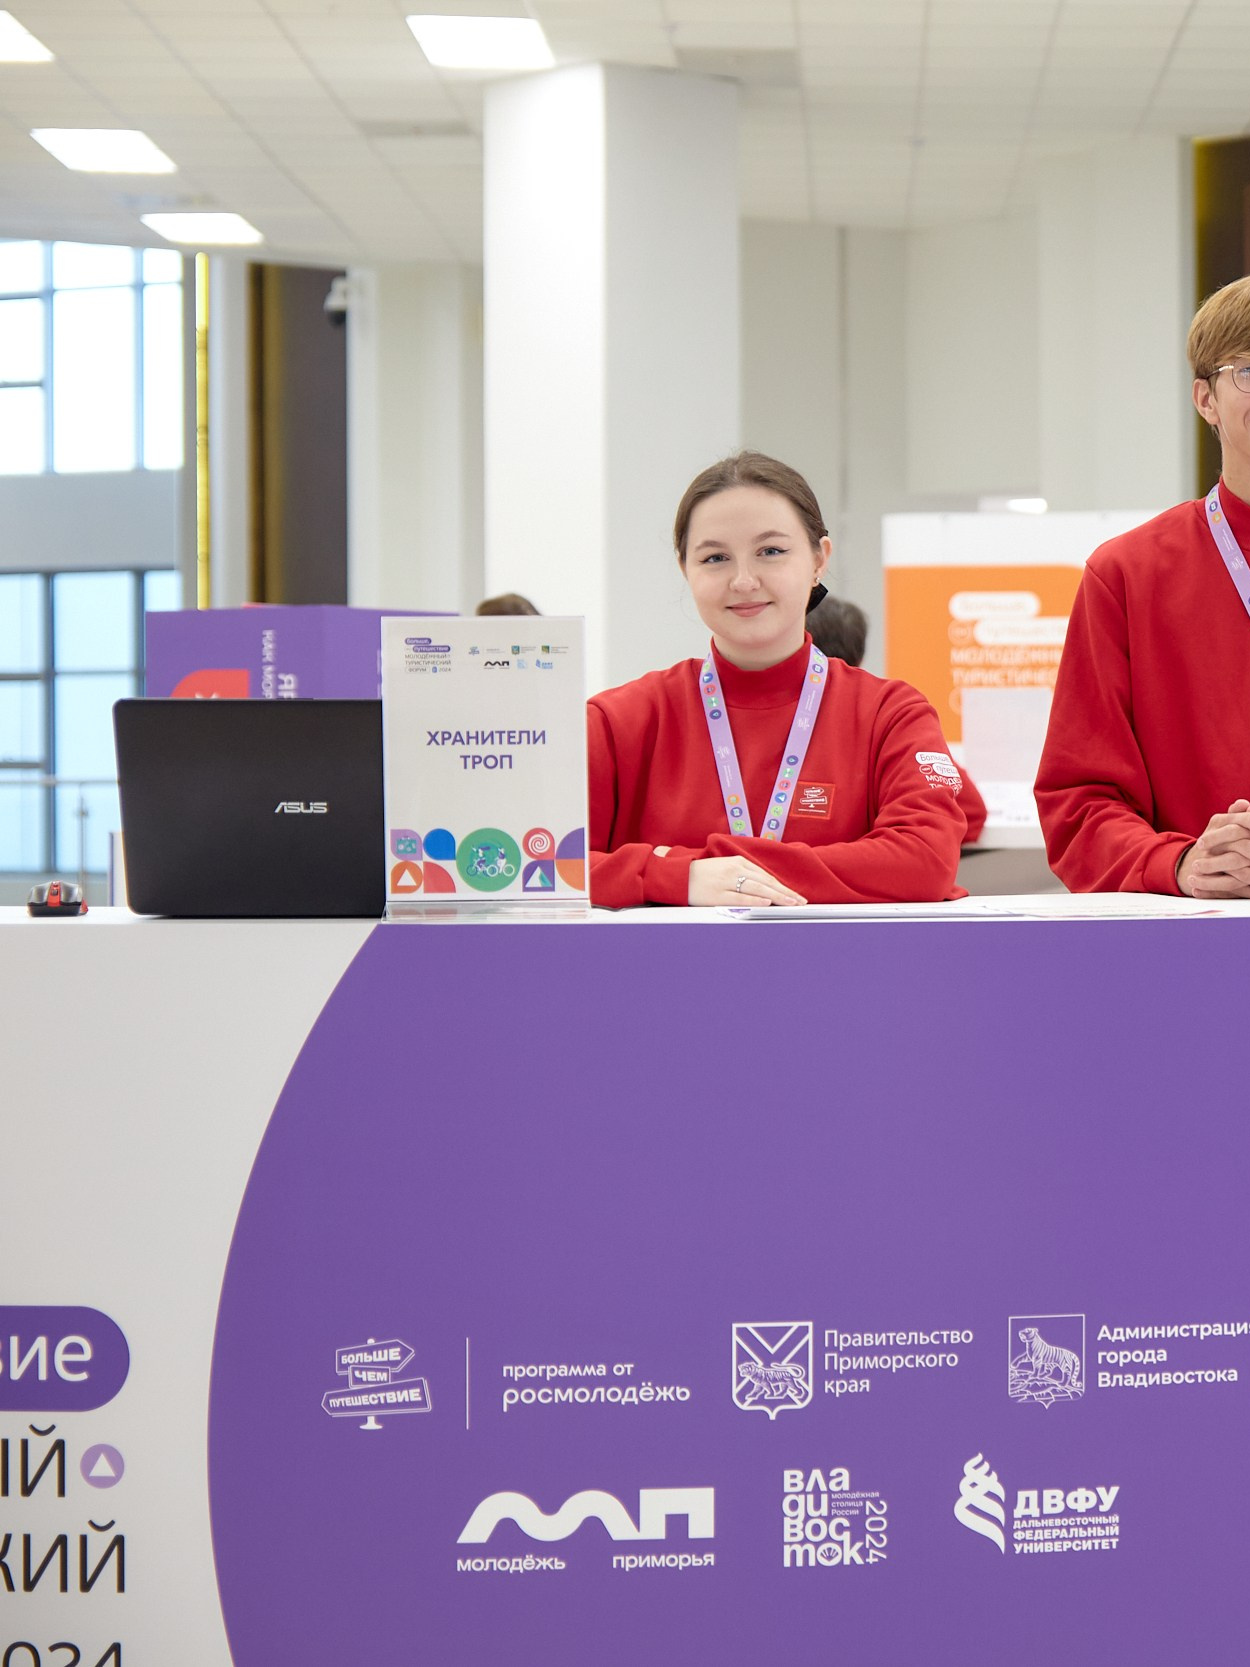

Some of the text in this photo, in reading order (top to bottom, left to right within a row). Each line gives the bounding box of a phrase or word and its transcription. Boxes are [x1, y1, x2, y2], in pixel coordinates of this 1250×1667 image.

[427, 730, 546, 746] ХРАНИТЕЛИ
[460, 754, 513, 770] ТРОП
[274, 801, 328, 814] ASUS
[824, 1329, 974, 1350] Правительство
[0, 1335, 93, 1382] ие
[341, 1347, 401, 1364] БОЛЬШЕ
[824, 1351, 959, 1374] Приморского
[1097, 1349, 1168, 1367] города
[354, 1370, 388, 1382] ЧЕМ
[502, 1363, 634, 1379] программа от
[1097, 1368, 1238, 1388] Владивостока
[824, 1378, 870, 1397] края
[329, 1388, 422, 1408] ПУТЕШЕСТВИЕ
[502, 1382, 691, 1412] росмолодёжь
[831, 1491, 880, 1499] молодёжная
[1013, 1486, 1120, 1519] ДВФУ
[1012, 1514, 1120, 1529] ДАЛЬНЕВОСТОЧНЫЙ
[865, 1500, 888, 1565] 2024
[1012, 1524, 1120, 1541] ФЕДЕРАЛЬНЫЙ
[1012, 1538, 1120, 1554] УНИВЕРСИТЕТ
[456, 1553, 715, 1573] молодёжь приморья
